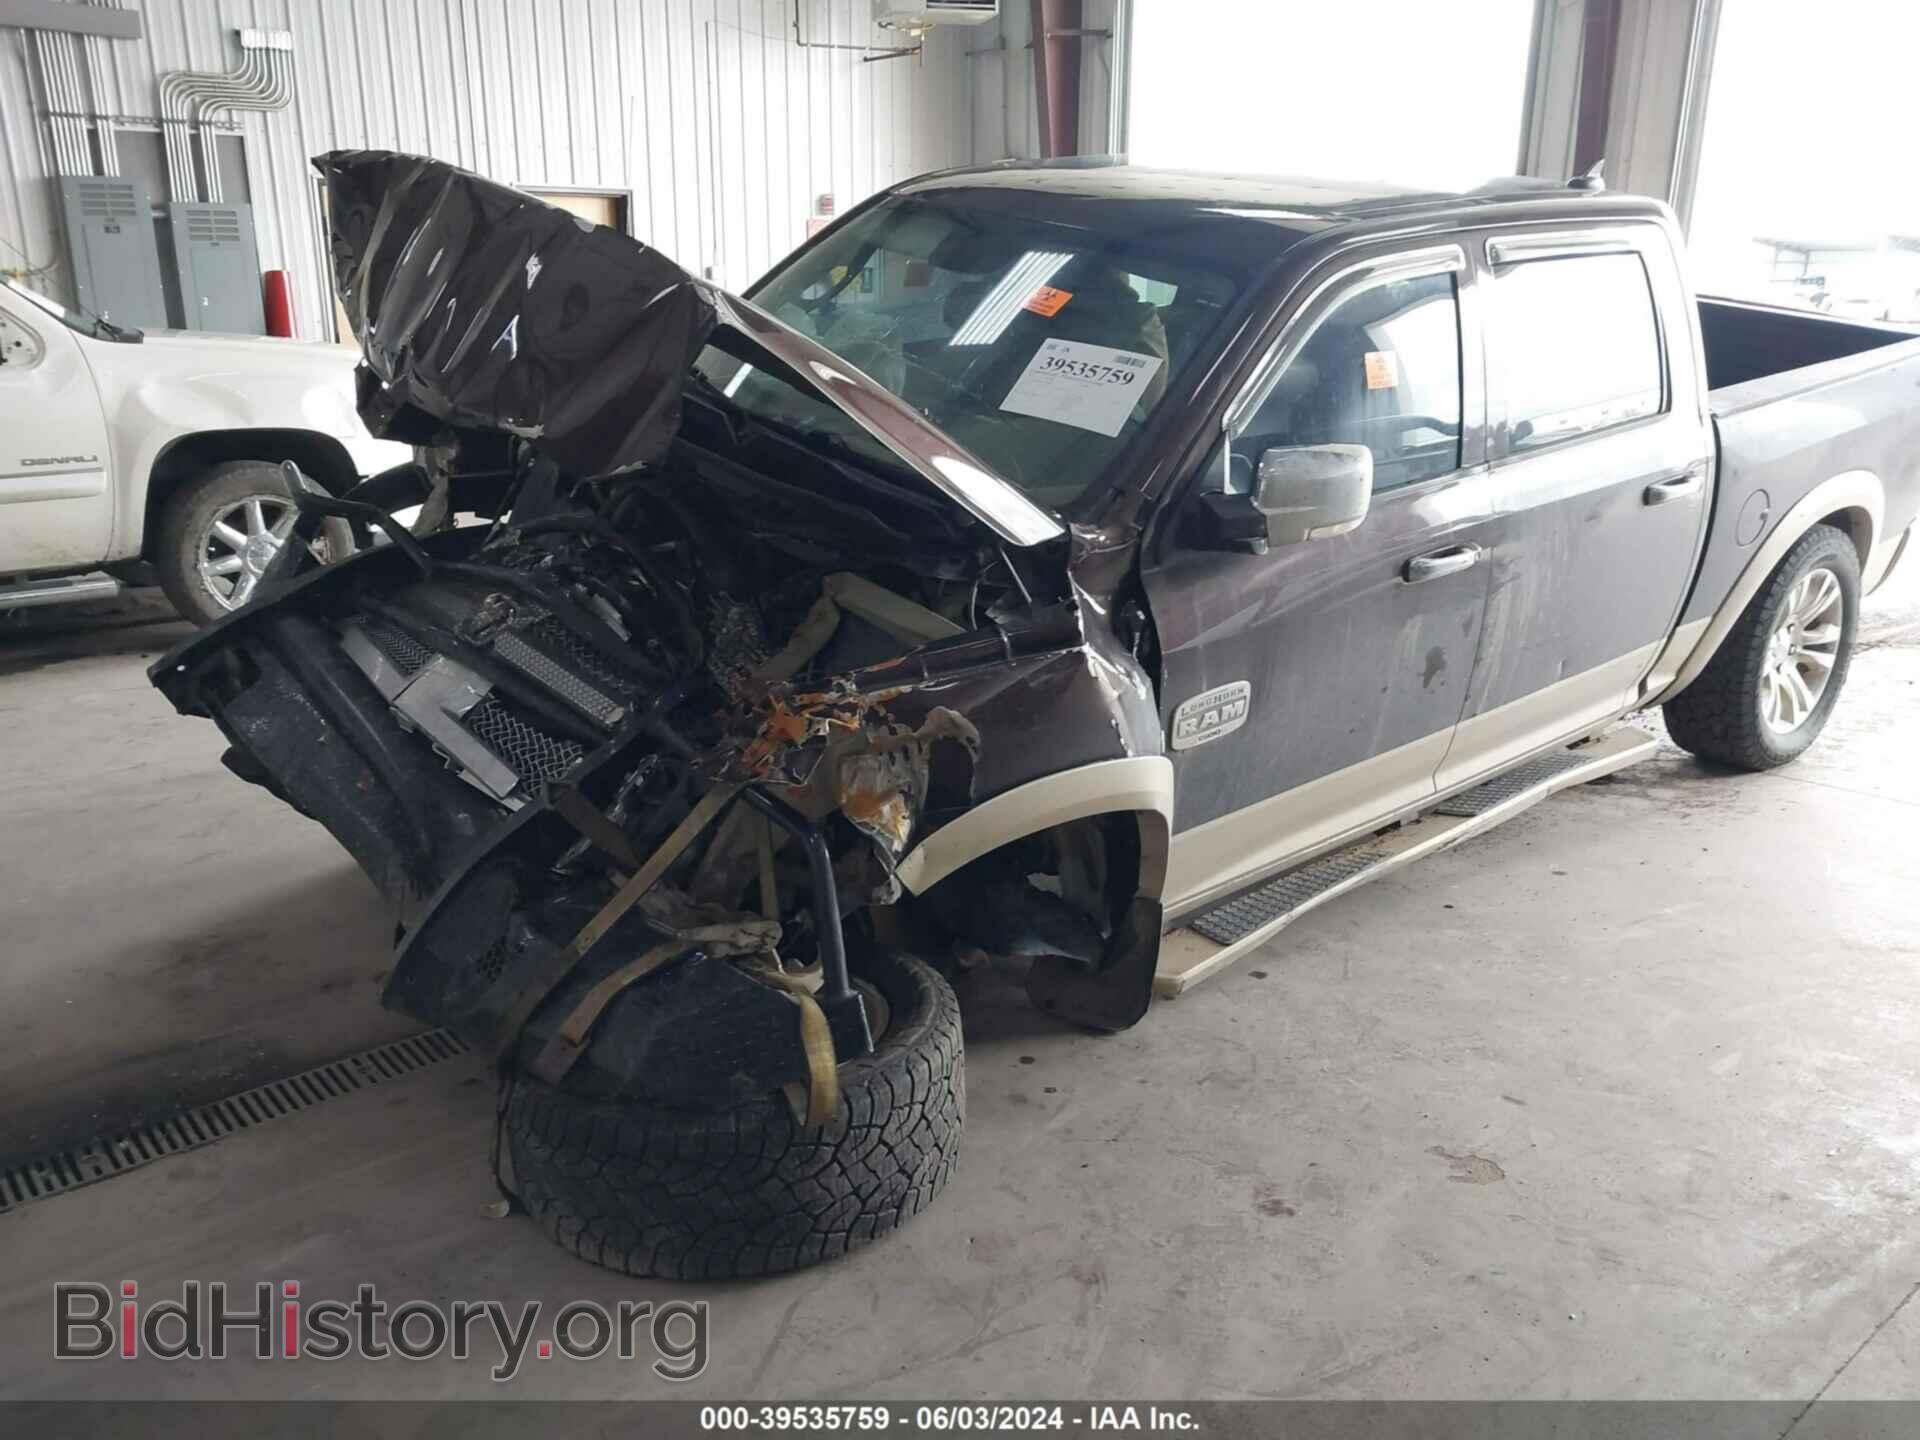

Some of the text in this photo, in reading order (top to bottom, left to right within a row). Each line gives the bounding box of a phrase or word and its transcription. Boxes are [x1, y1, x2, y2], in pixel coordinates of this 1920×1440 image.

[1040, 356, 1135, 386] 39535759
[20, 455, 98, 466] DENALI
[1178, 698, 1246, 738] RAM
